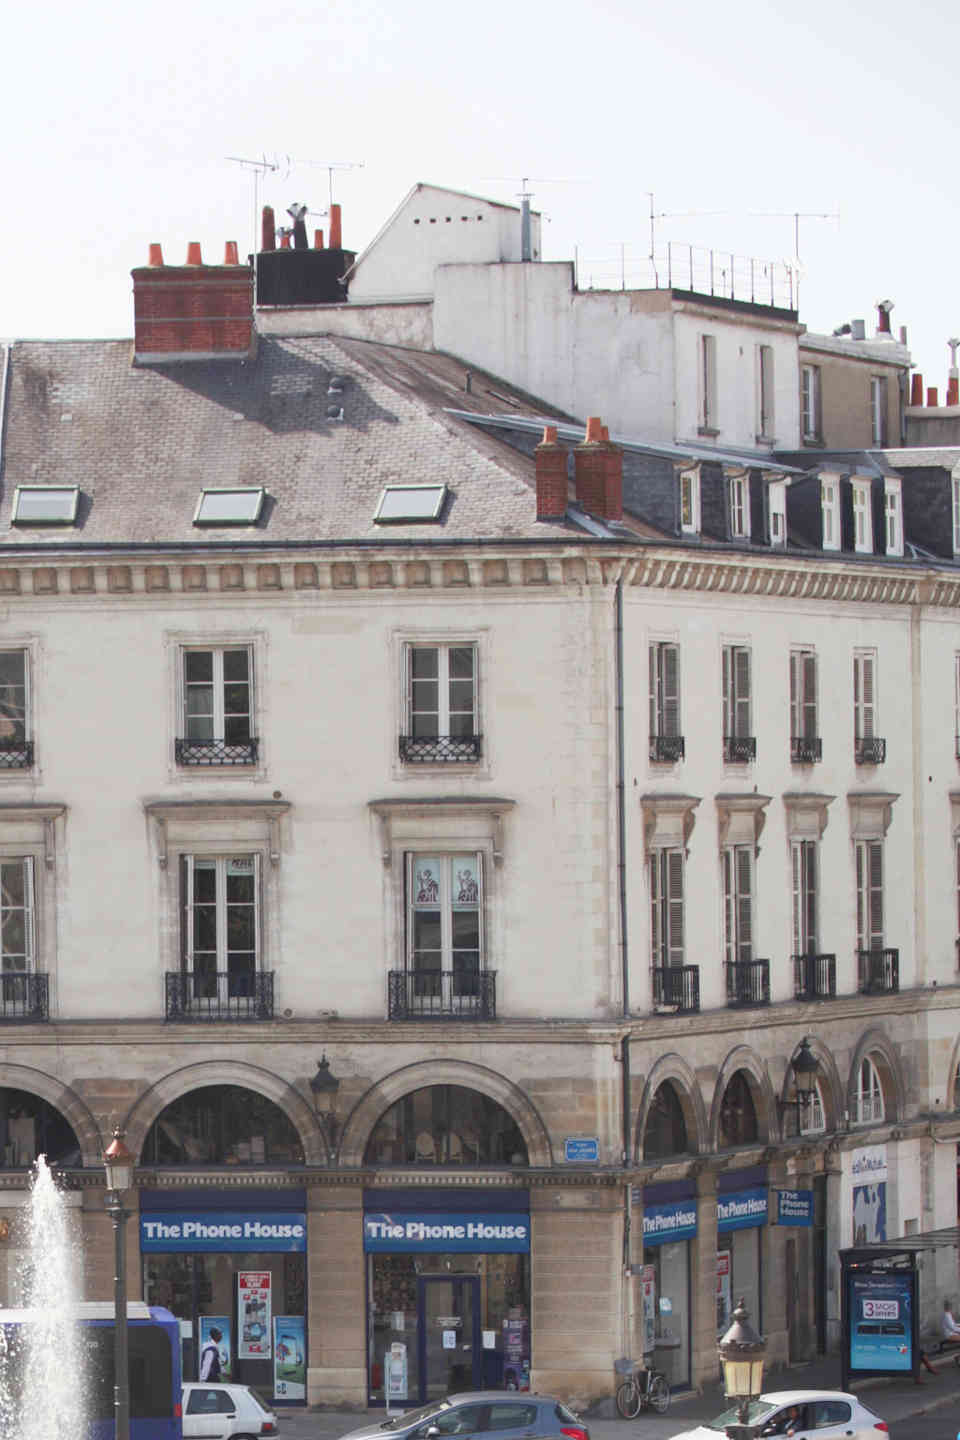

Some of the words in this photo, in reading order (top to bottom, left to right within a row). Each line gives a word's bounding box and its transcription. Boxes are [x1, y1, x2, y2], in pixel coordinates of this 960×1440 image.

[781, 1191, 798, 1200] The
[717, 1202, 728, 1219] The
[728, 1200, 747, 1217] Phone
[748, 1198, 768, 1215] House
[781, 1200, 809, 1209] Phone
[781, 1208, 809, 1217] House
[643, 1216, 656, 1232] The
[655, 1213, 675, 1231] Phone
[675, 1211, 696, 1227] House
[143, 1222, 181, 1238] The
[182, 1222, 241, 1238] Phone
[244, 1222, 304, 1238] House
[367, 1222, 404, 1239] The
[405, 1222, 465, 1240] Phone
[467, 1222, 527, 1240] House
[865, 1302, 874, 1317] 3
